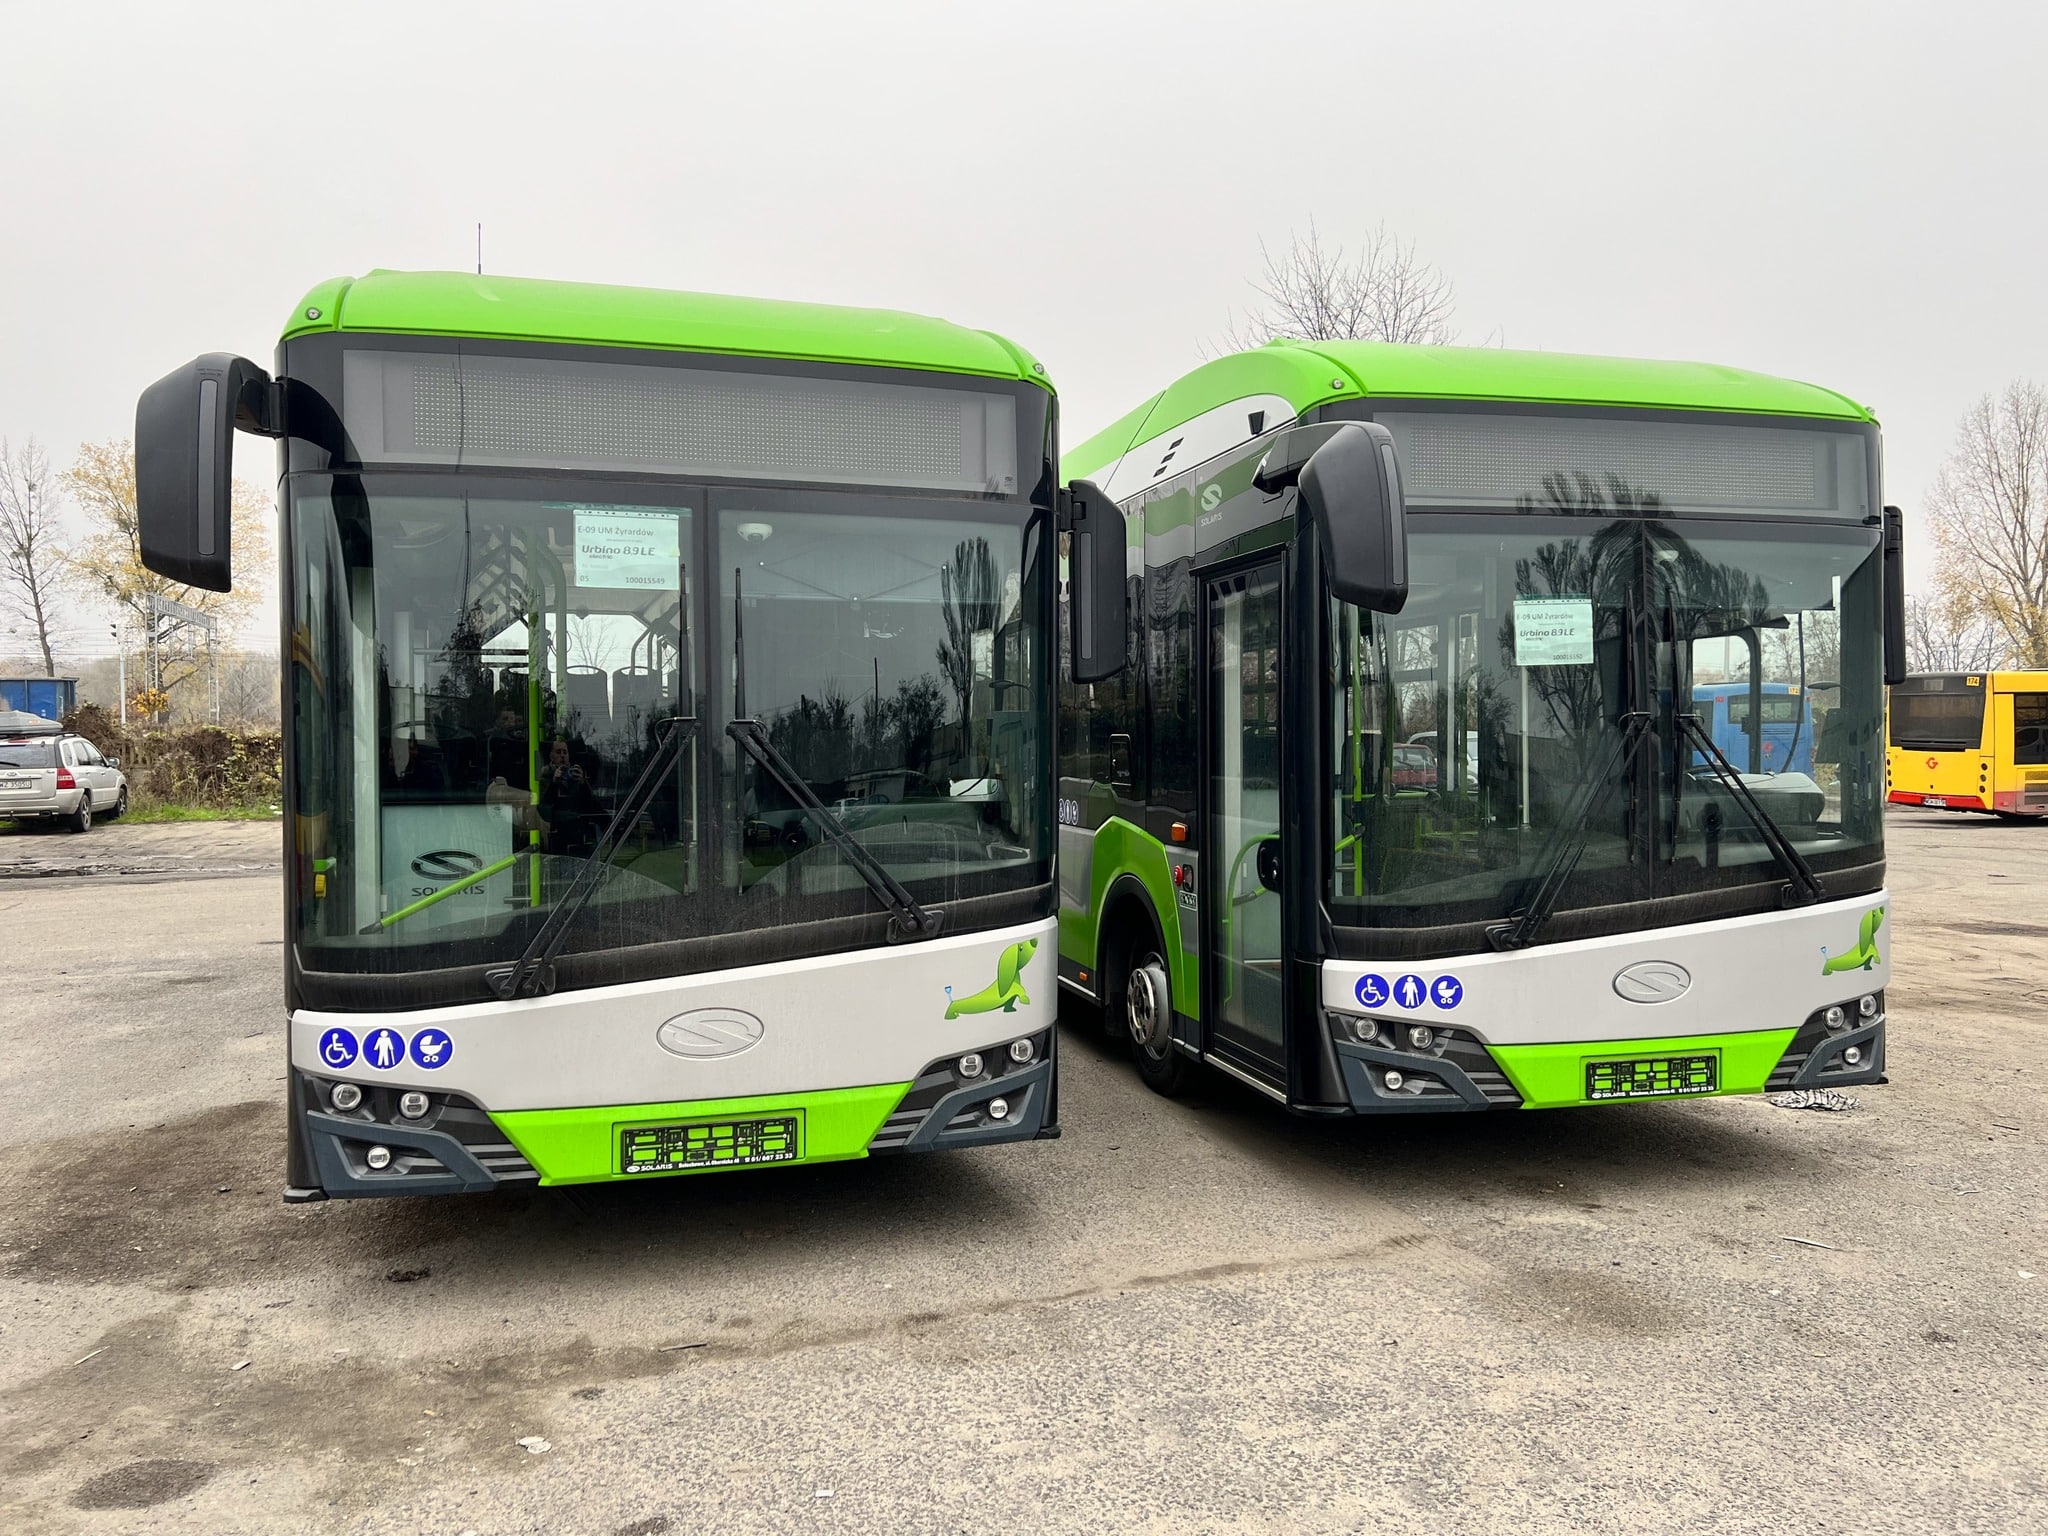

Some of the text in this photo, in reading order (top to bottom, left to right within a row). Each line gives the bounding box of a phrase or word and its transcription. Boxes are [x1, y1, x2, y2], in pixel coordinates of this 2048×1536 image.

[578, 525, 654, 537] E-09 UM Żyrardów
[582, 545, 621, 555] Urbino
[1520, 629, 1549, 637] Urbino
[641, 1163, 673, 1172] SOLARIS
